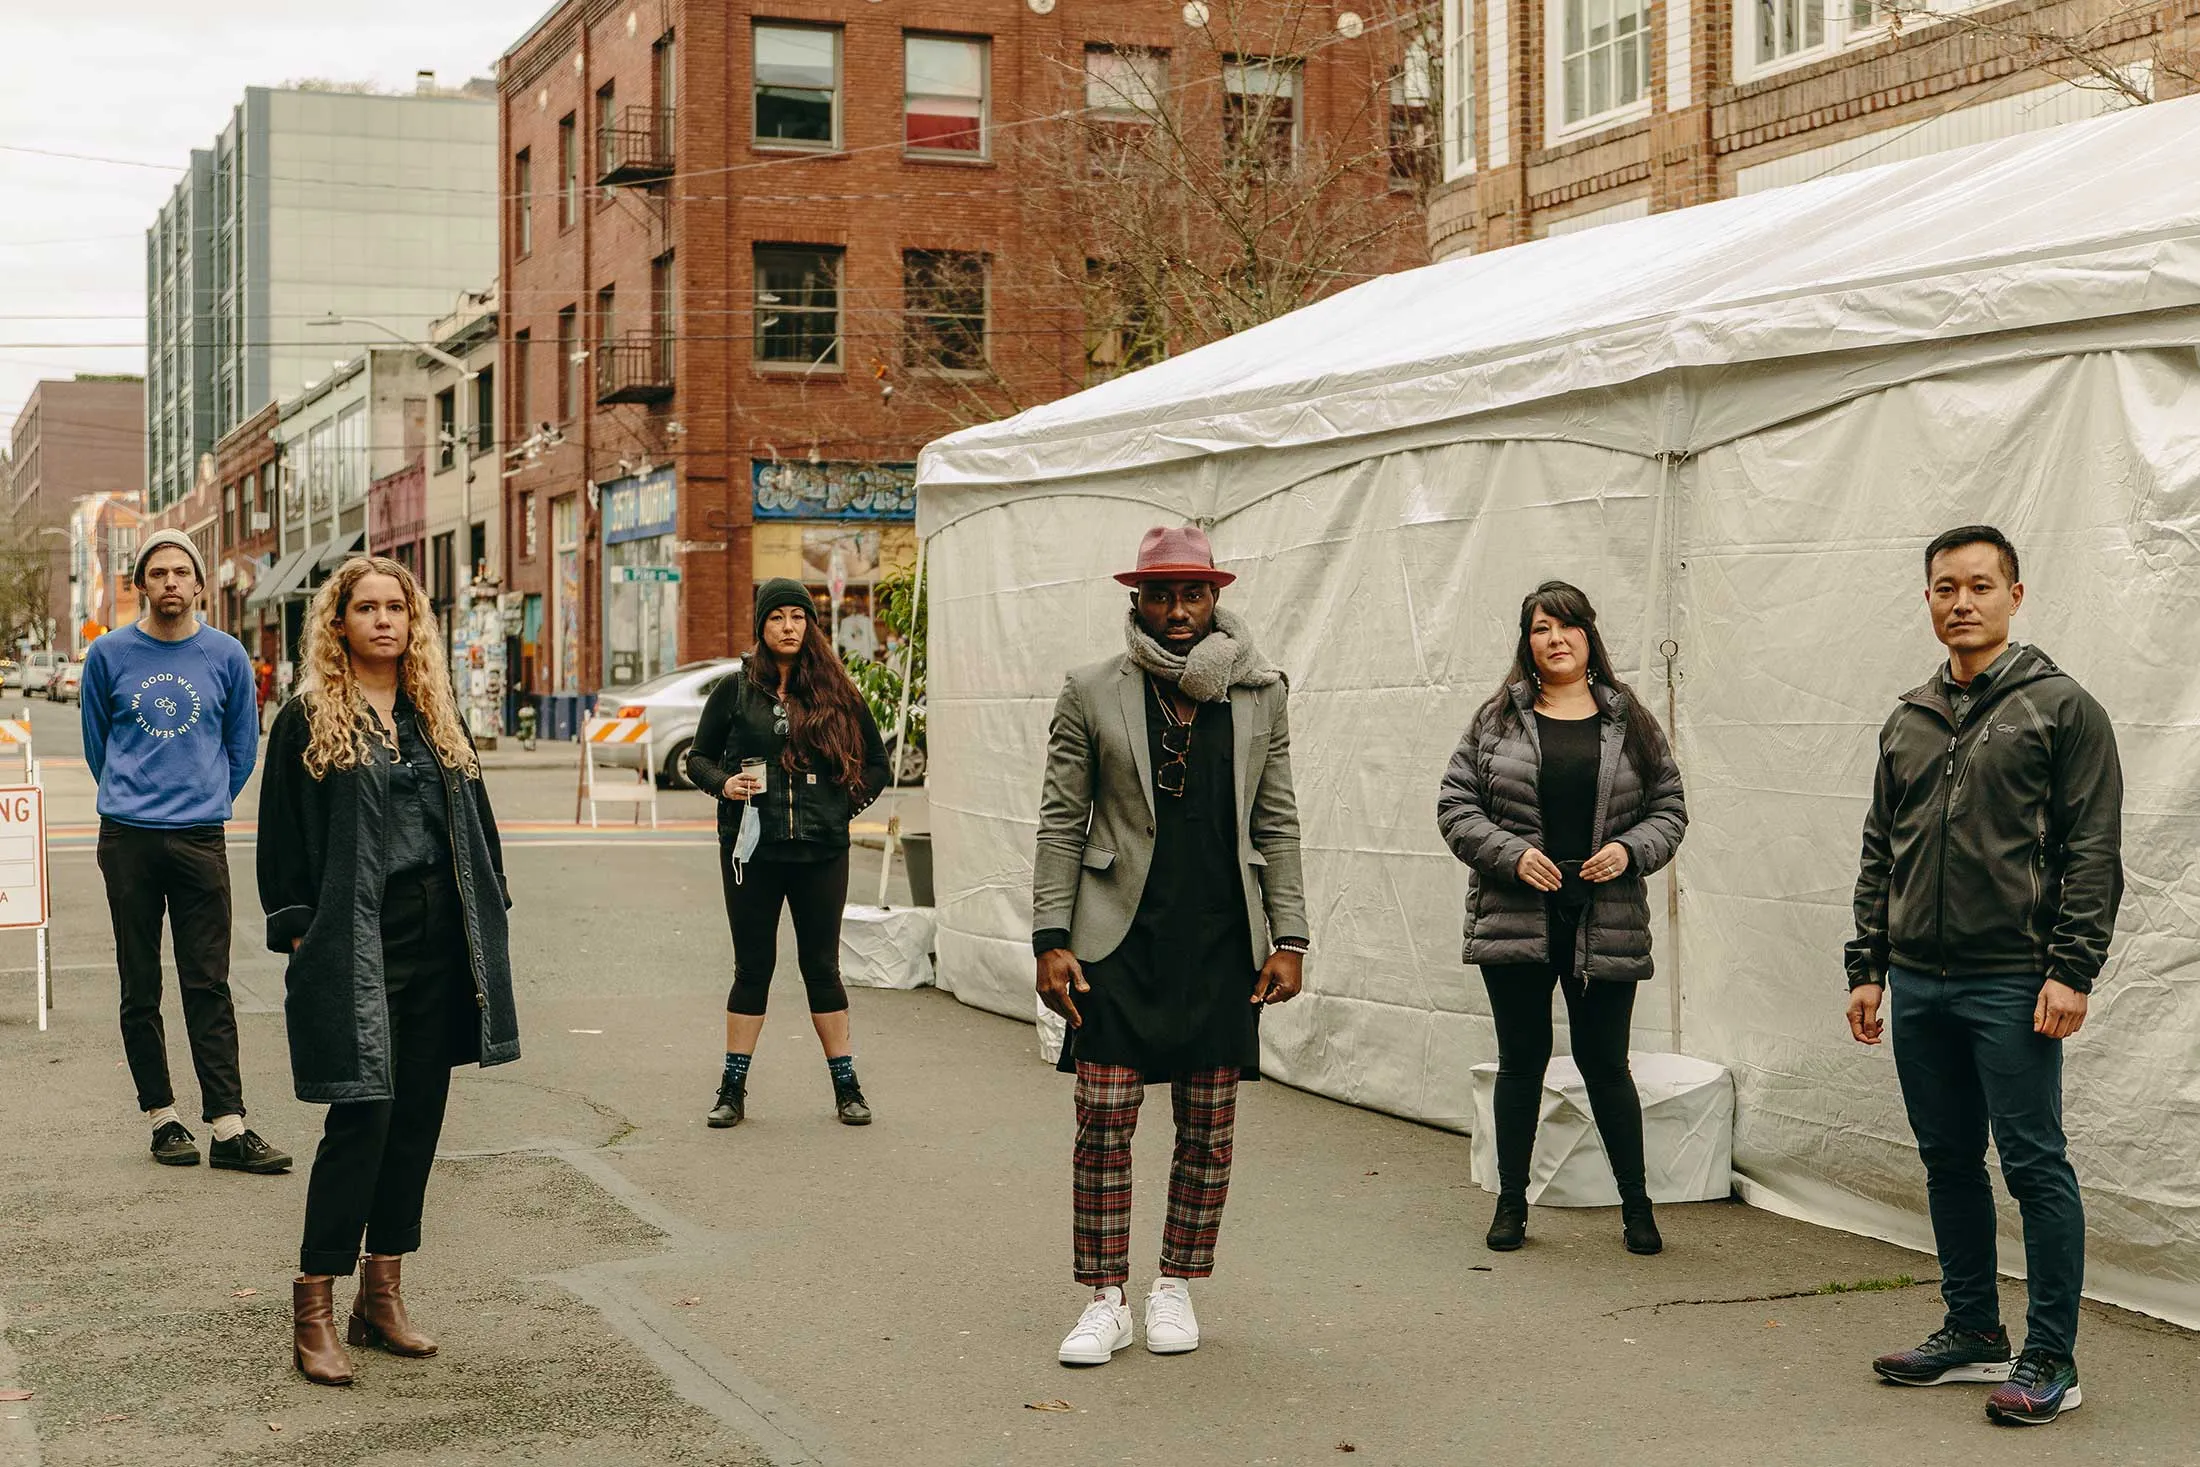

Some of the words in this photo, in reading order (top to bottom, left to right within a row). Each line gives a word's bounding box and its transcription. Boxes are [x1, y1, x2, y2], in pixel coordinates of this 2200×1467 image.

[639, 480, 671, 527] NORTH
[141, 673, 174, 689] GOOD
[131, 693, 142, 710] WA
[177, 676, 201, 724] WEATHER
[135, 712, 175, 739] SEATTLE,
[177, 723, 191, 735] IN
